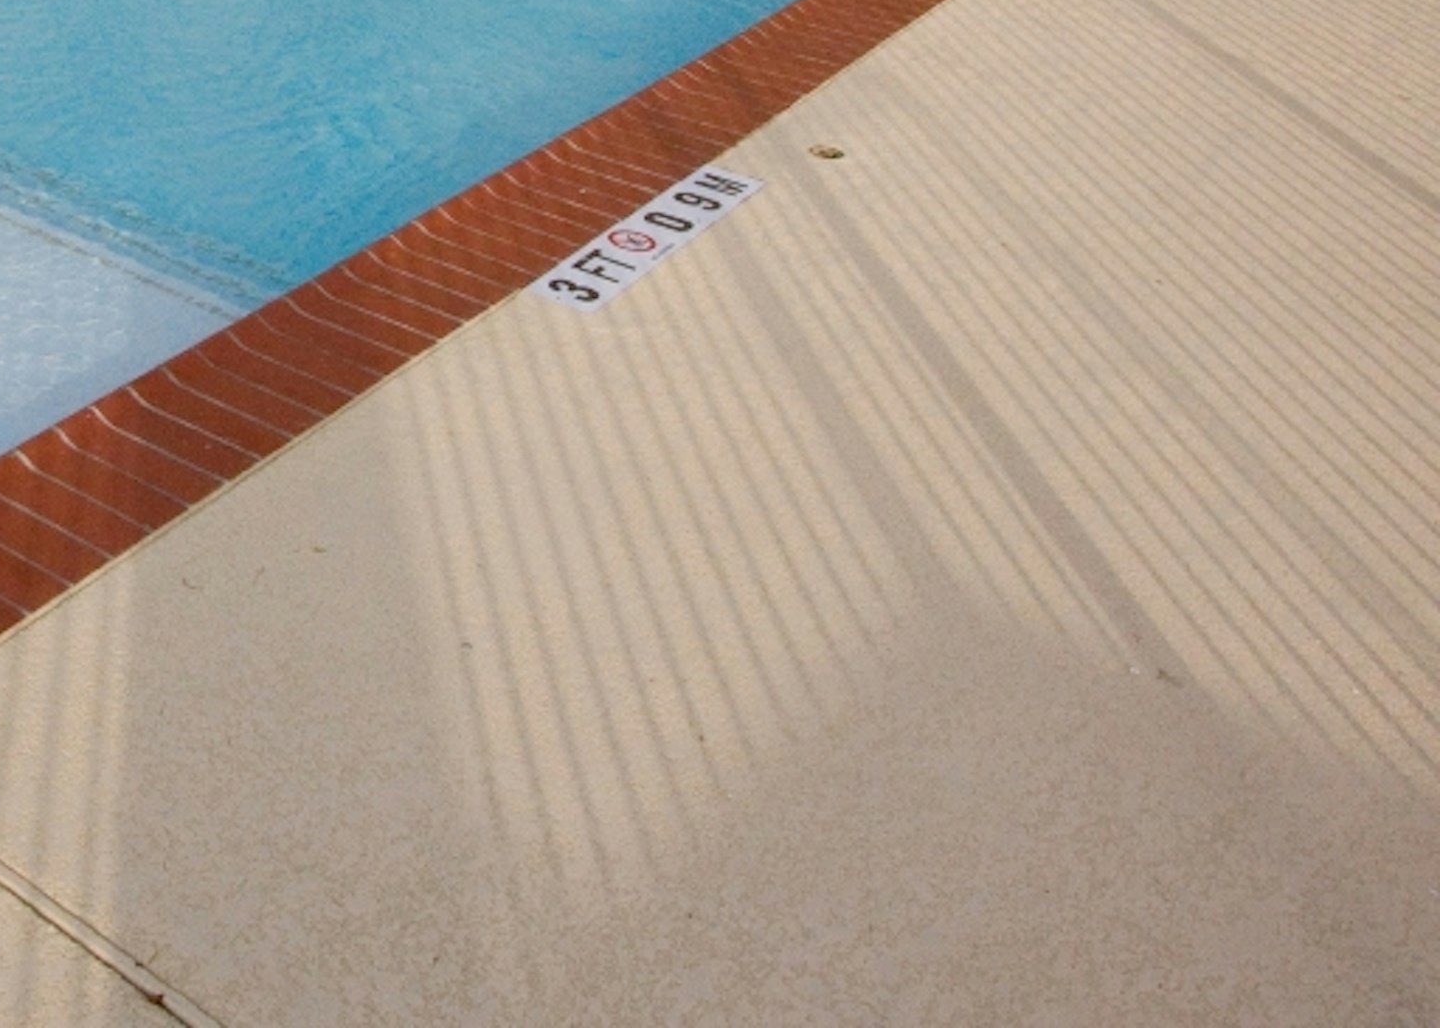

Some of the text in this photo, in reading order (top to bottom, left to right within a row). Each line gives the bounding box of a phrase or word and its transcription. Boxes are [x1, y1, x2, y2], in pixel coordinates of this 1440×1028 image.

[694, 172, 749, 196] M
[571, 249, 636, 283] FT
[548, 278, 600, 302] 3
